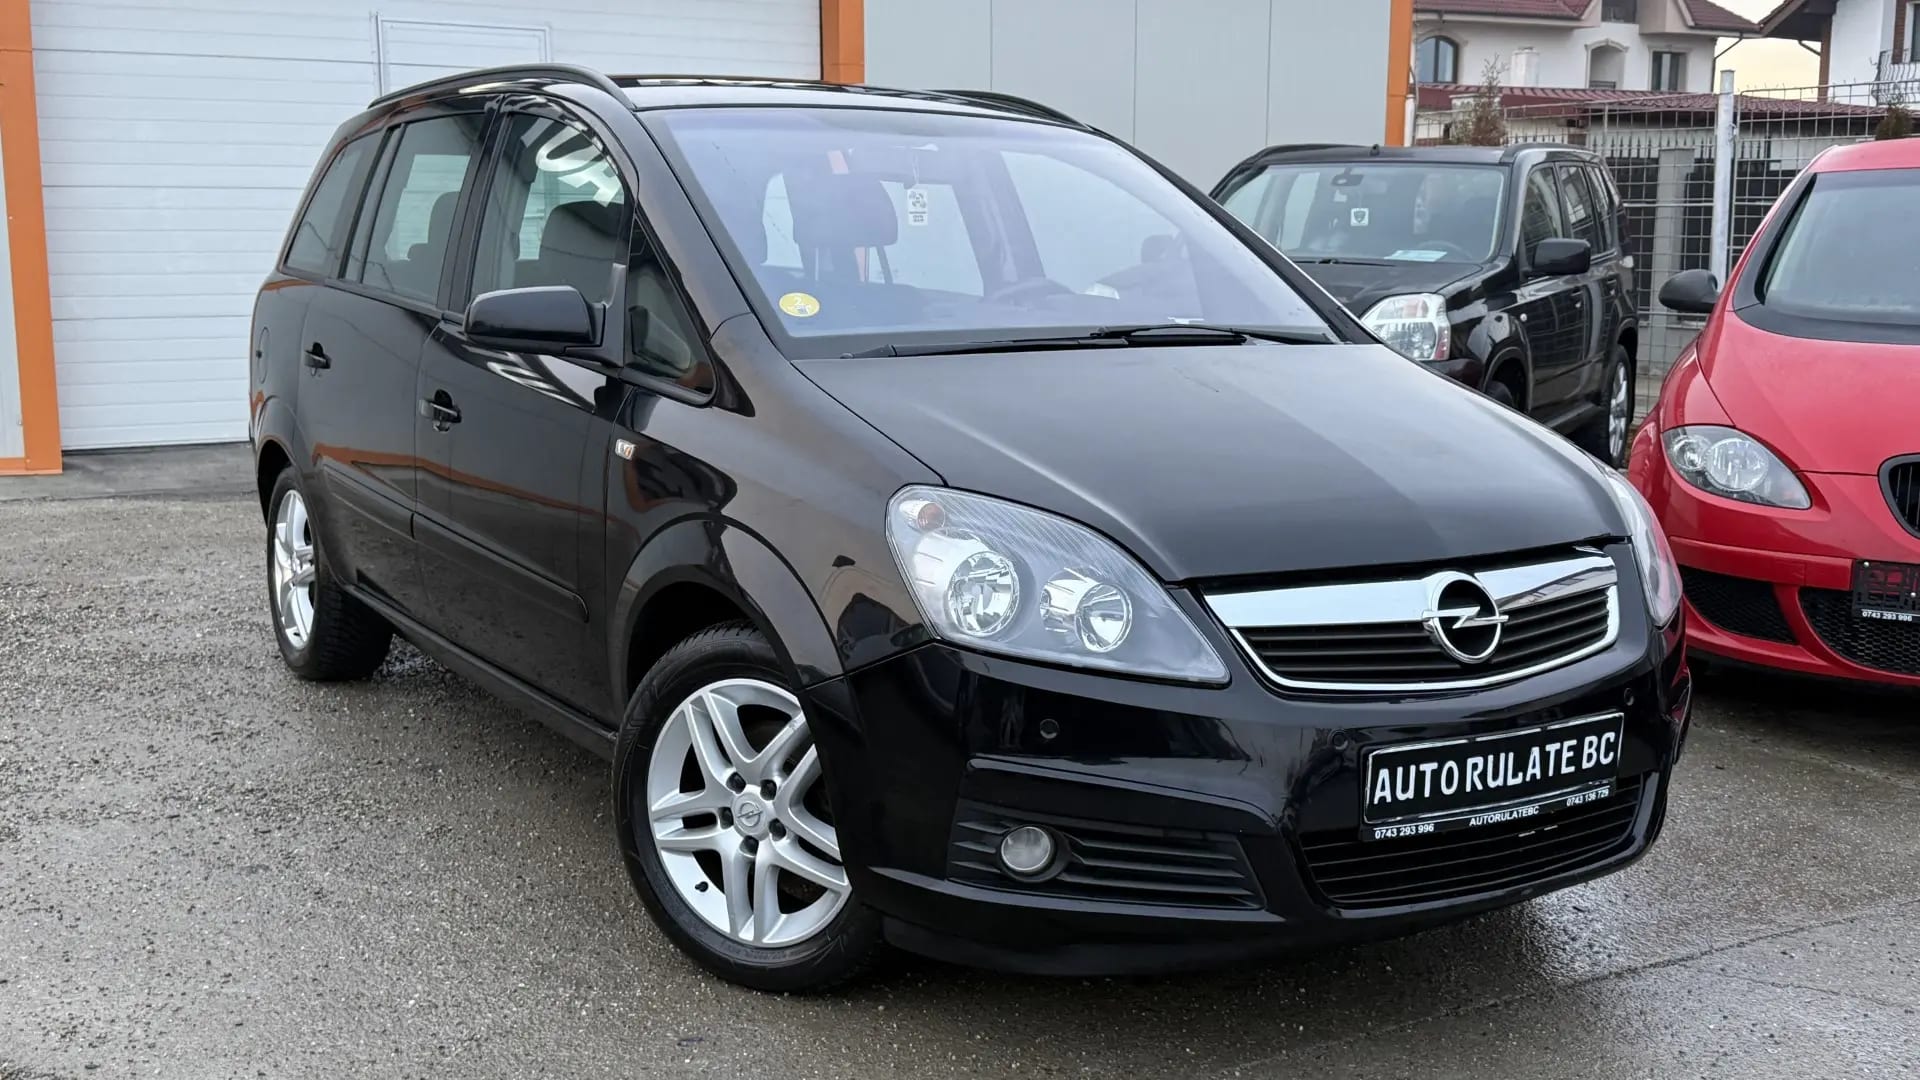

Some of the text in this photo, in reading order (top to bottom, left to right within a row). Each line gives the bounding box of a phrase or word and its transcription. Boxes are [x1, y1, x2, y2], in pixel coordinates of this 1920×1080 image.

[1862, 611, 1880, 619] 0743
[1581, 731, 1616, 769] BC
[1566, 795, 1583, 807] 0743
[1585, 792, 1597, 802] 136
[1469, 805, 1539, 827] AUTORULATEBC
[1374, 823, 1435, 840] 0743 293 996
